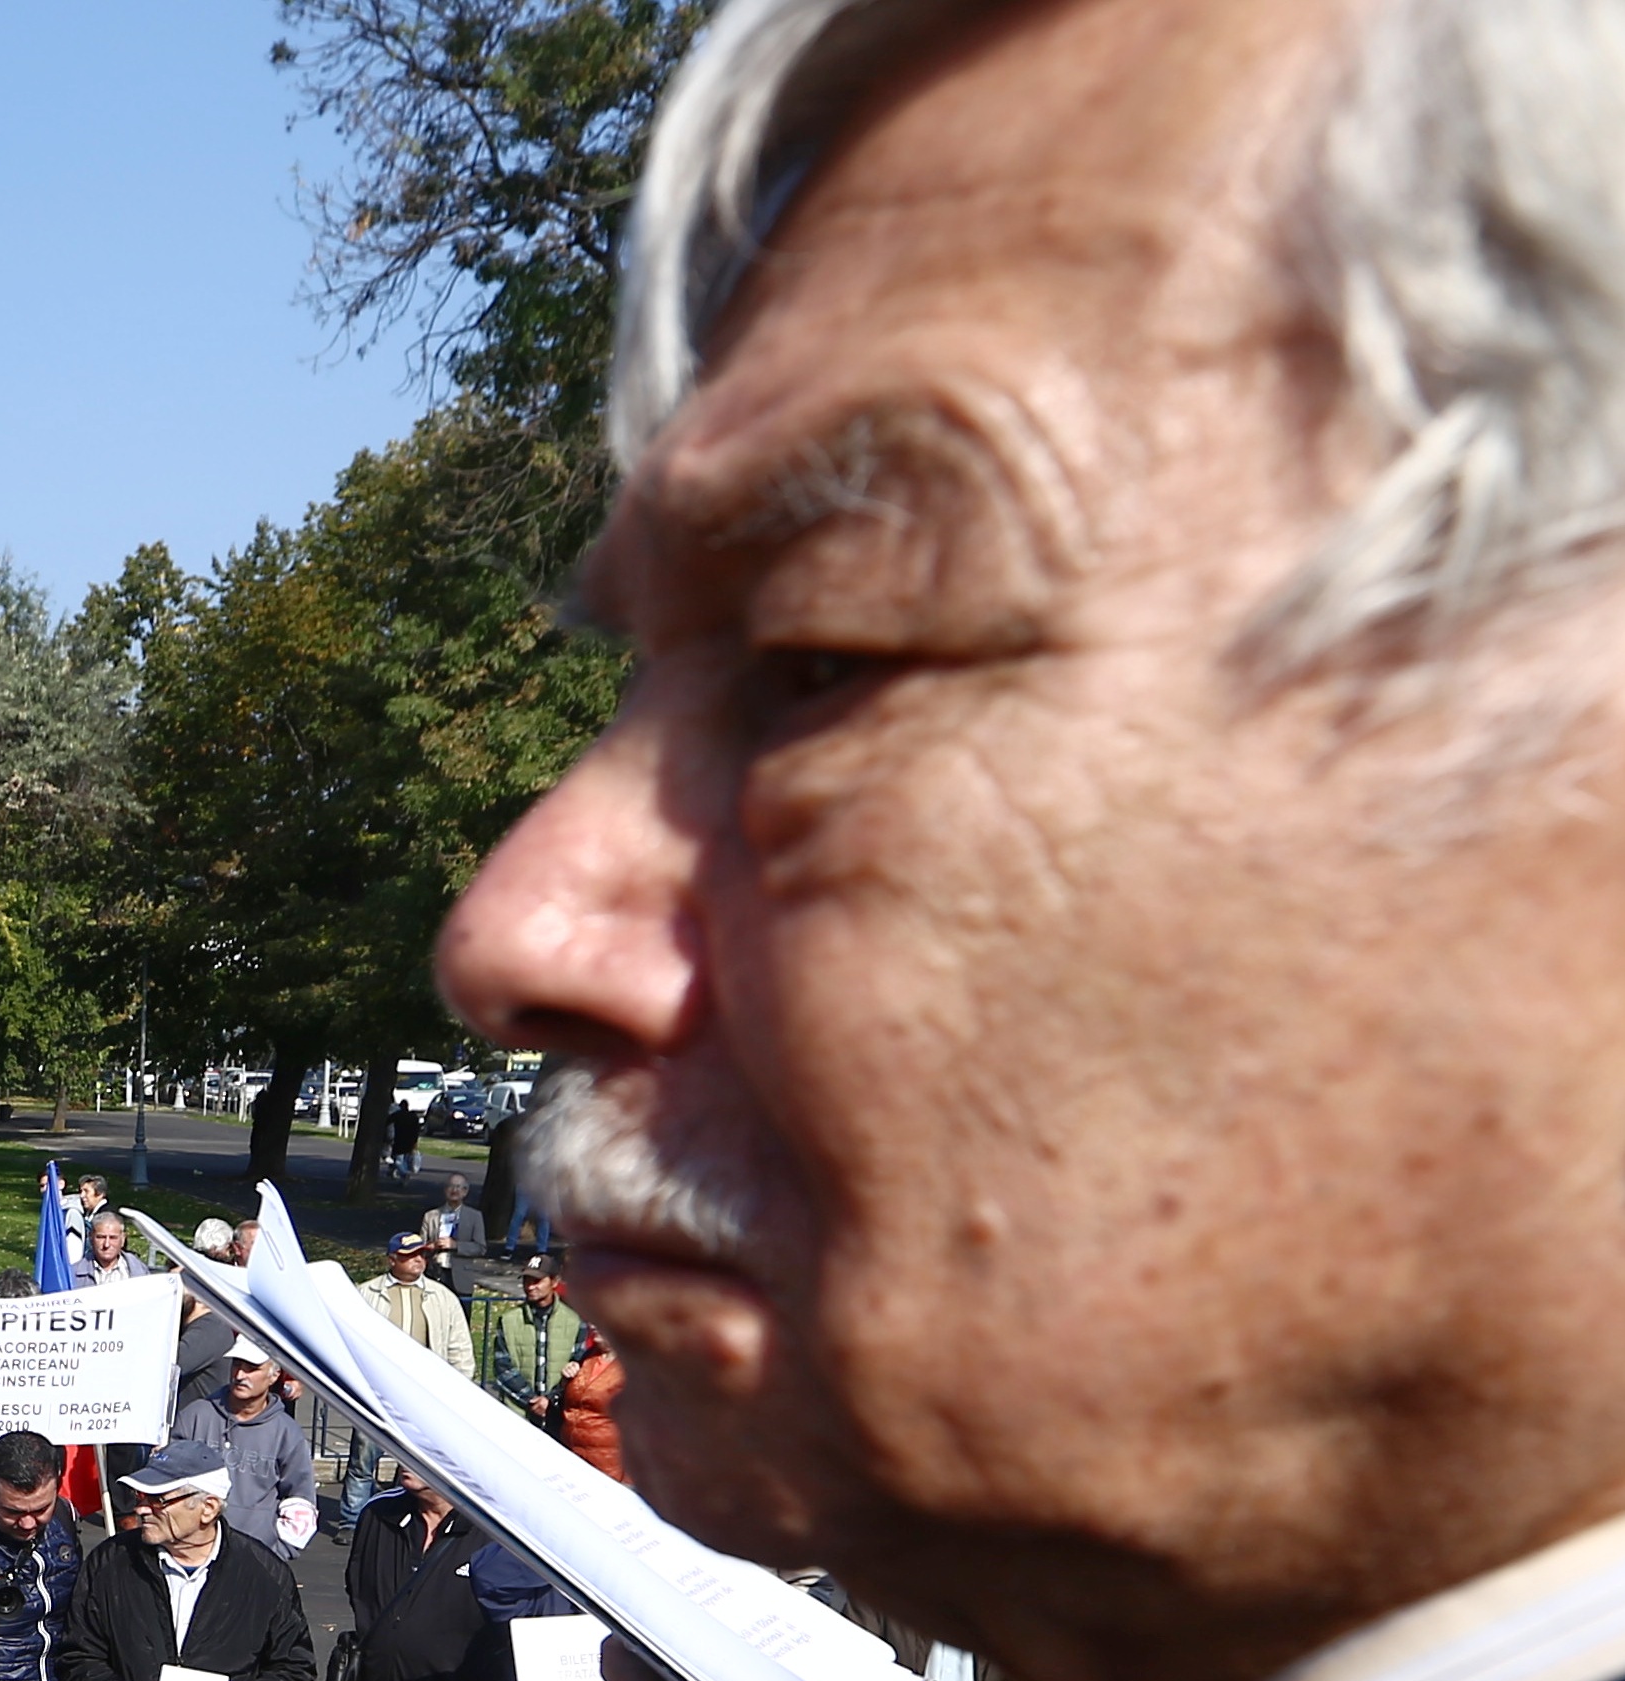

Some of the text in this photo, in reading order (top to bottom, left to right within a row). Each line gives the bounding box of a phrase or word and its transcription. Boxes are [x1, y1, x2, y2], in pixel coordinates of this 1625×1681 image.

[24, 1297, 83, 1310] UNIREA
[1, 1309, 115, 1332] PITESTI
[72, 1341, 87, 1354] IN
[91, 1340, 124, 1353] 2009
[51, 1375, 76, 1388] LUI
[58, 1400, 132, 1416] DRAGNEA
[87, 1417, 119, 1431] 2021
